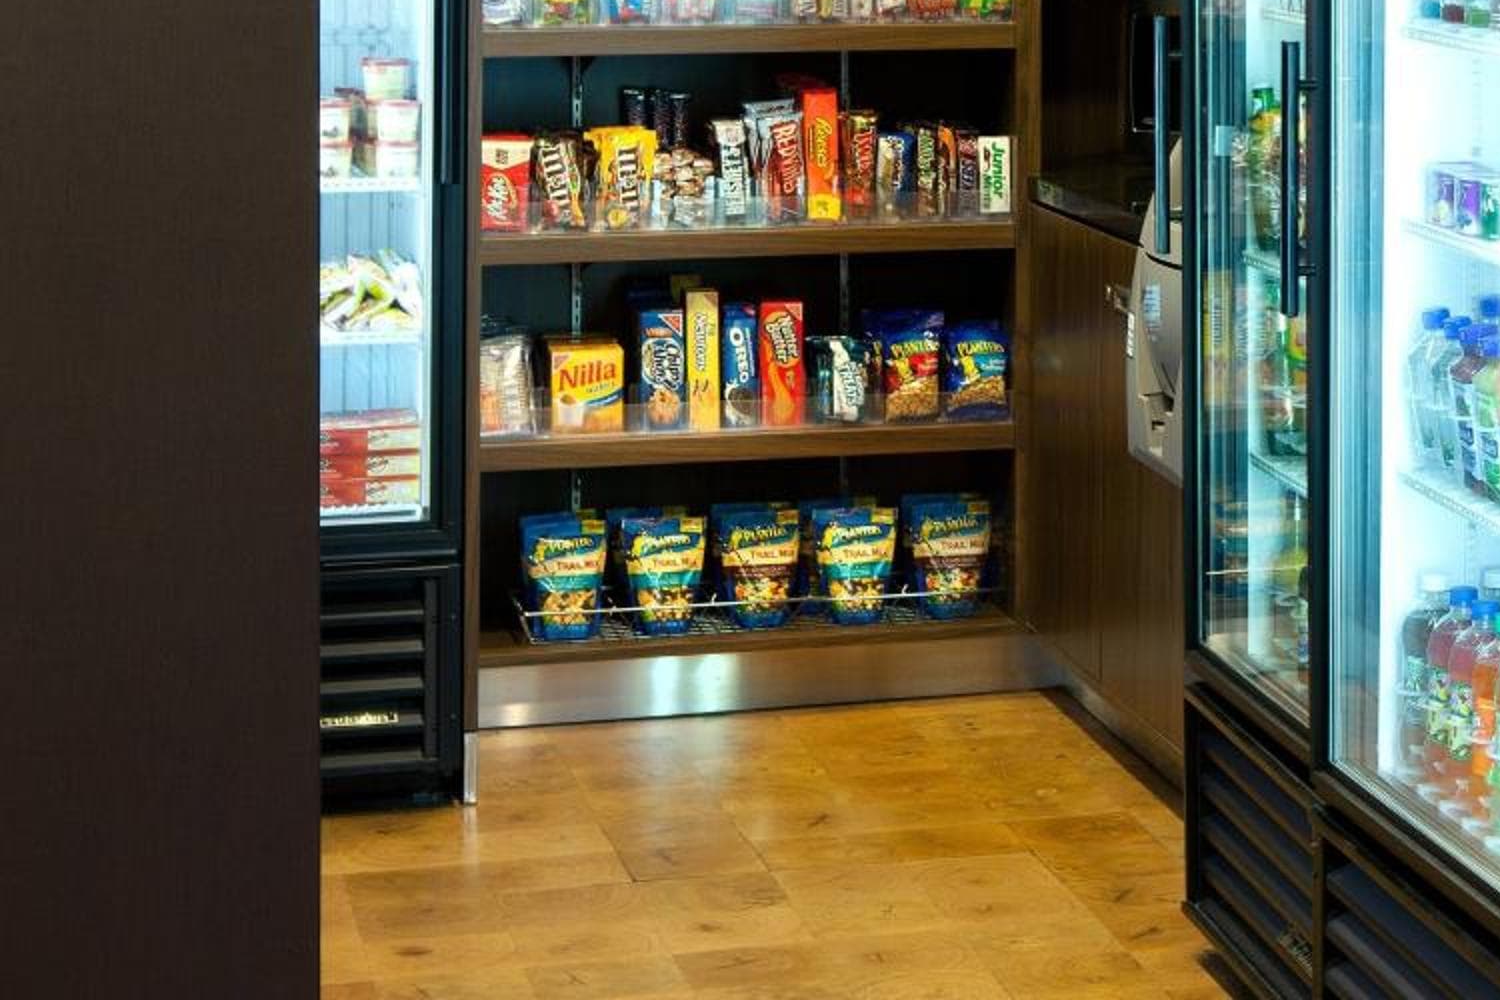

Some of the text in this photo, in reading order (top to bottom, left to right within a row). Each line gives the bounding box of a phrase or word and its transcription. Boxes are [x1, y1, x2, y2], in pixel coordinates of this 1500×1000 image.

[990, 142, 1006, 199] Junior
[559, 359, 616, 392] Nilla
[729, 326, 748, 383] OREO
